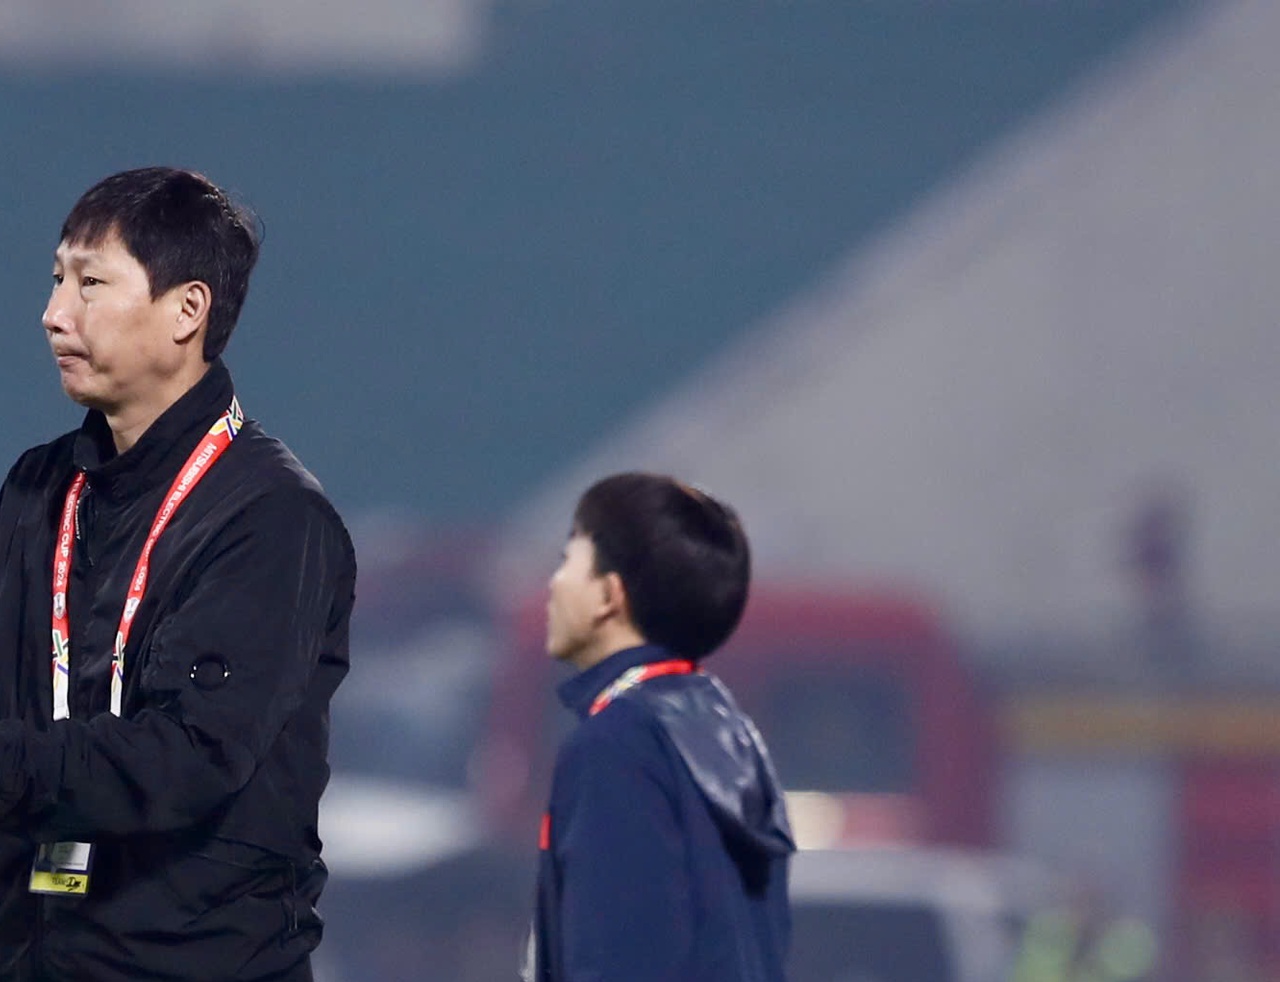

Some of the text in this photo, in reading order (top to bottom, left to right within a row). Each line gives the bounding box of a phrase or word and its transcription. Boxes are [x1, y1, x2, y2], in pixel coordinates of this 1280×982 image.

[177, 442, 217, 491] MITSUBISHI
[63, 483, 80, 531] ELECTRIC
[153, 490, 182, 536] ELECTRIC
[61, 533, 69, 558] CUP
[56, 561, 66, 587] 2024
